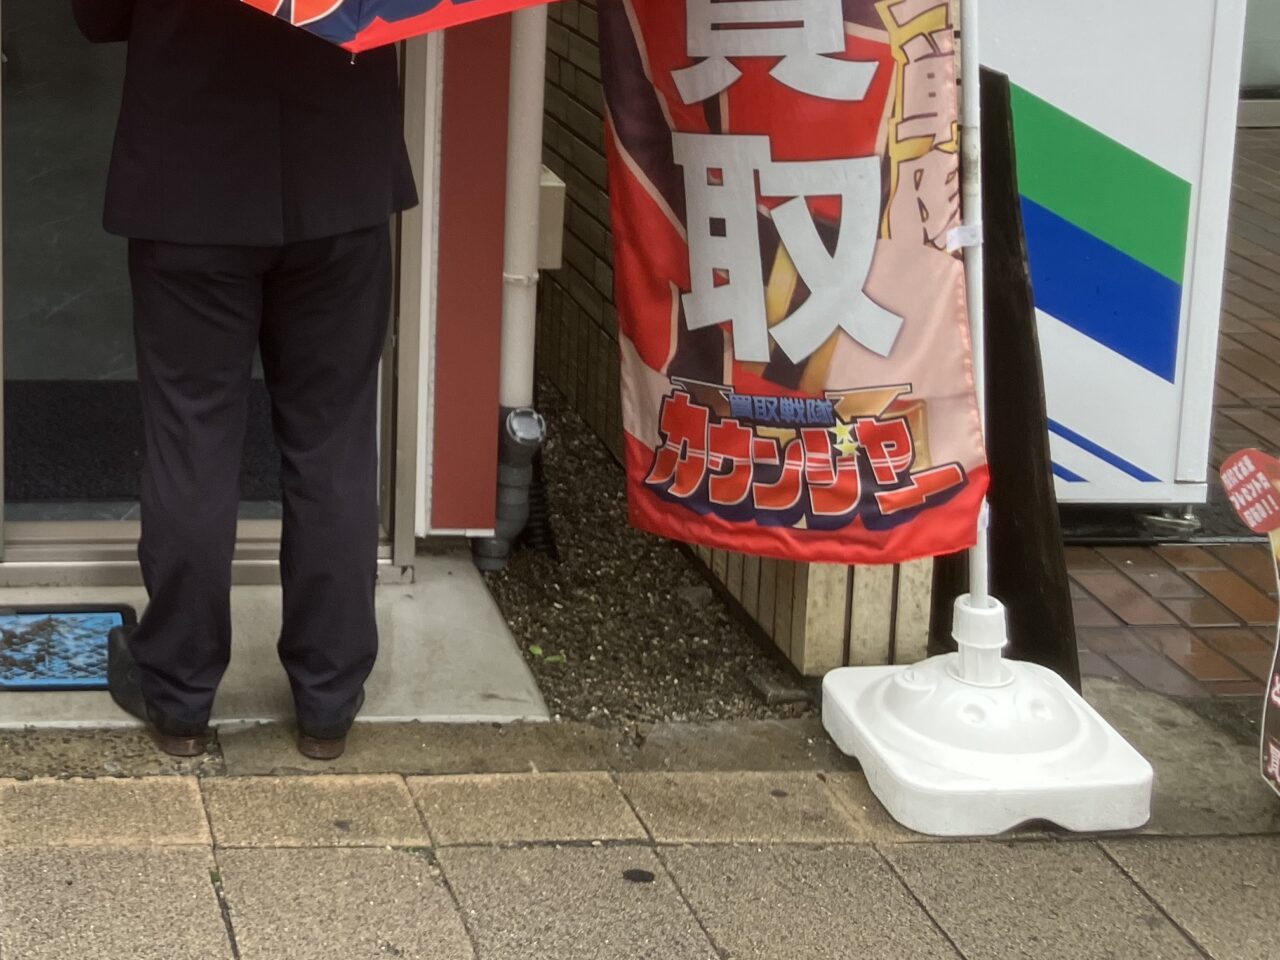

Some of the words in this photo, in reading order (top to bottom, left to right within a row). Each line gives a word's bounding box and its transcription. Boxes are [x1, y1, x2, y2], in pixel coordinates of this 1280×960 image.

[729, 394, 836, 424] 買取戦隊
[643, 389, 968, 517] カウンジャー
